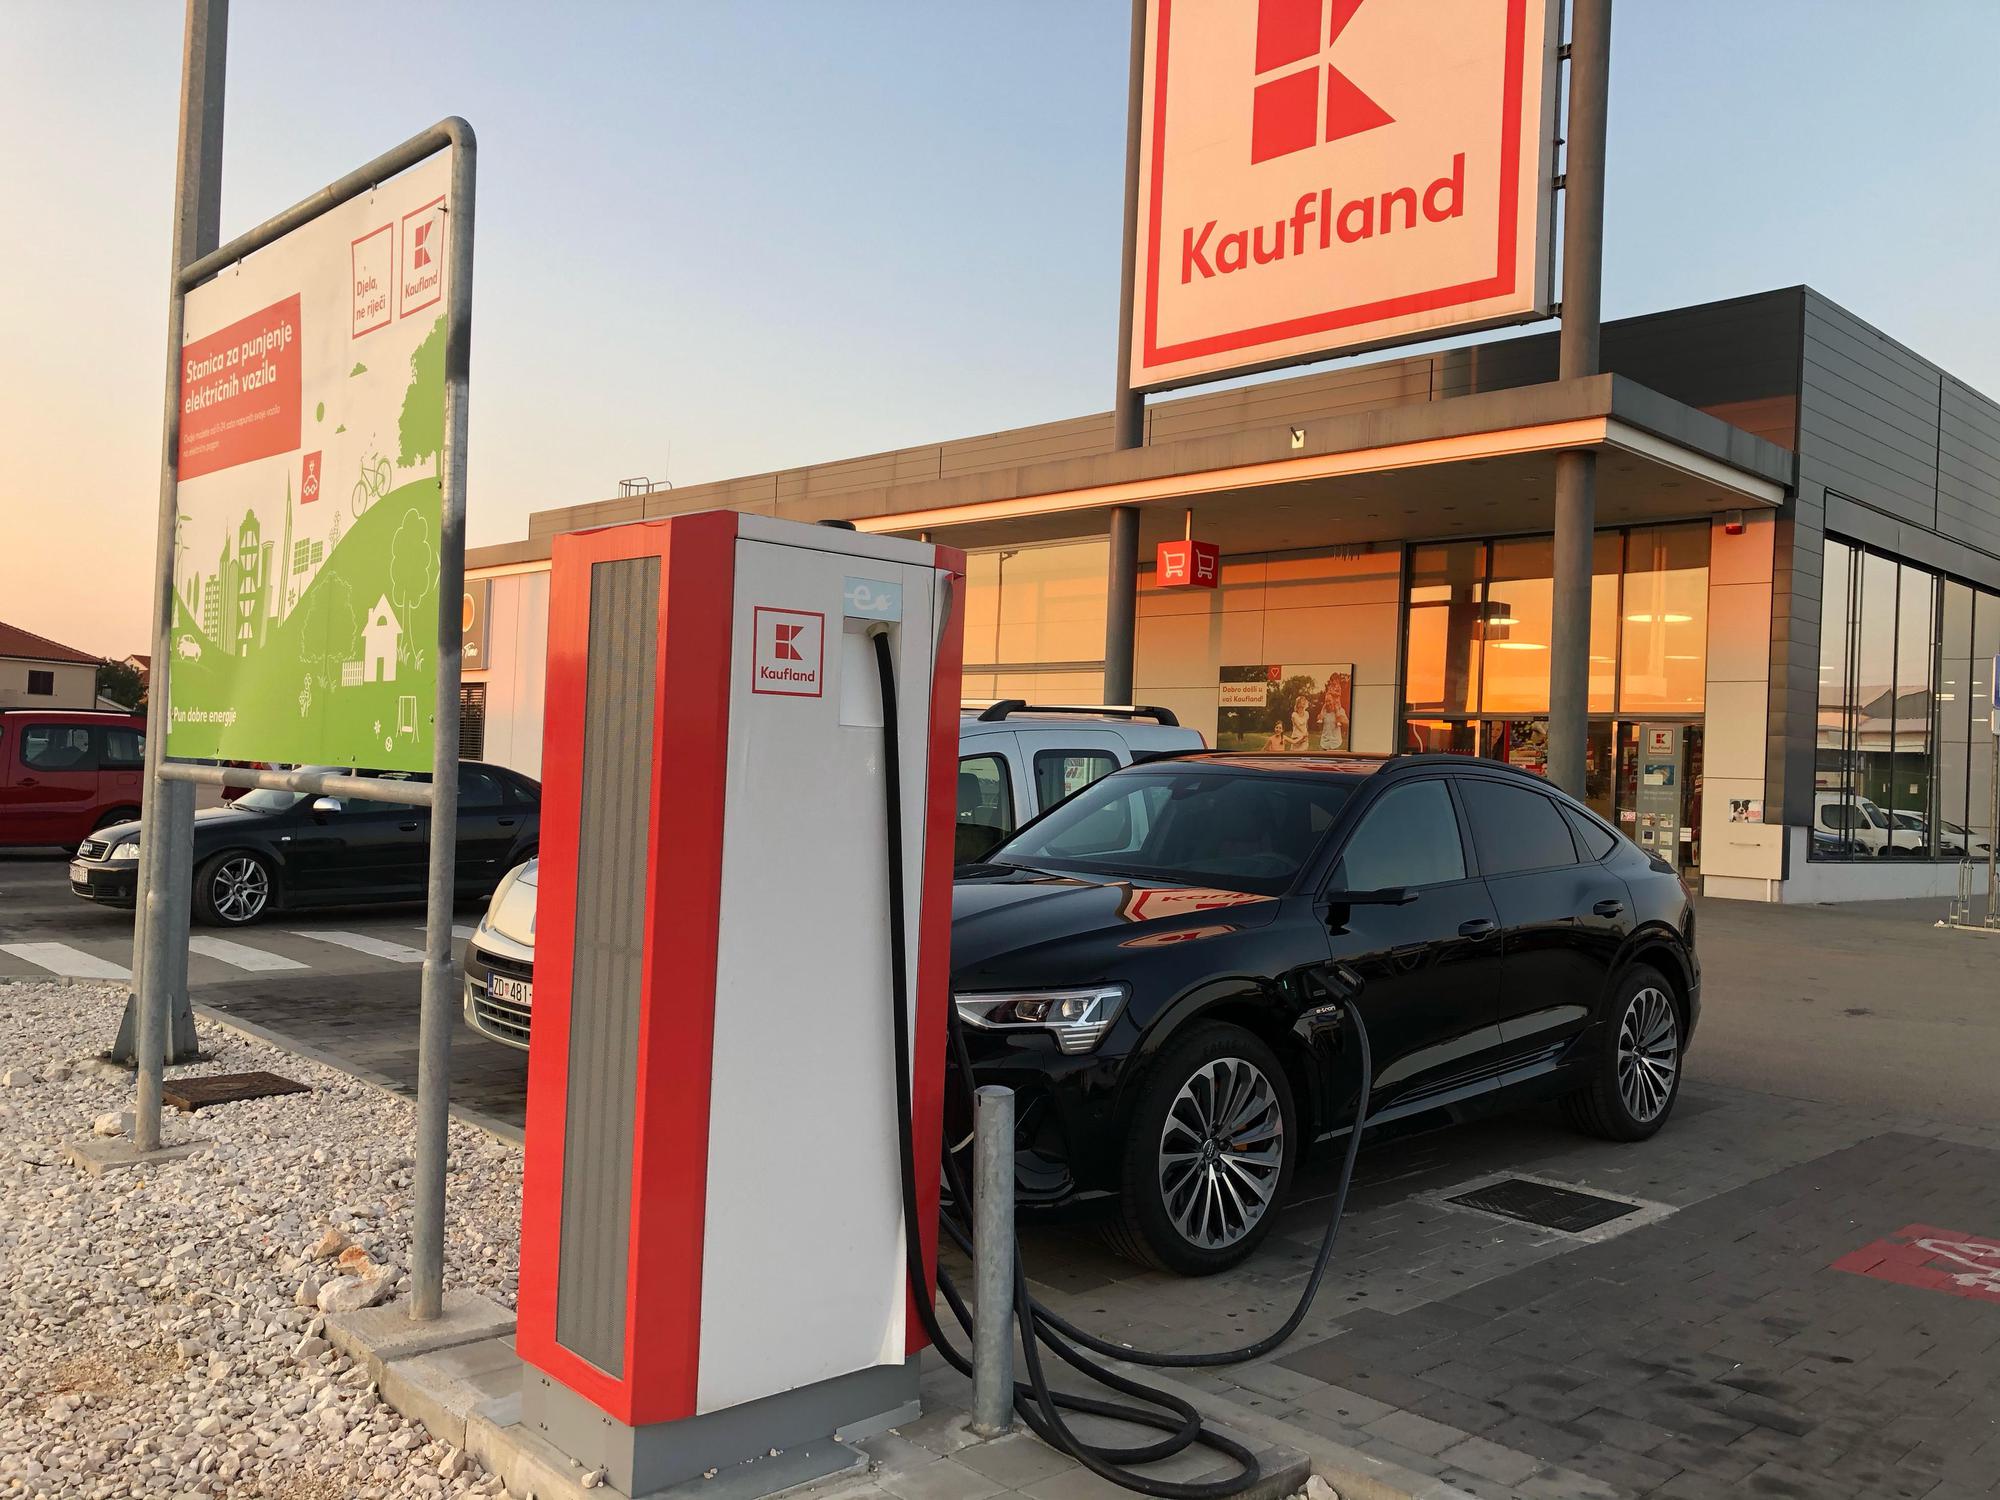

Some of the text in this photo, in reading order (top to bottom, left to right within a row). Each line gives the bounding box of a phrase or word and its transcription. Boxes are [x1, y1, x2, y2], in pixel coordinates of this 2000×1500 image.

[1181, 152, 1465, 285] Kaufland
[356, 276, 378, 298] Djela,
[404, 269, 438, 299] Kaufland
[356, 294, 386, 321] ne riječi
[186, 320, 293, 384] Stanica za punjenje
[185, 360, 276, 414] električnih vozila
[760, 666, 815, 682] Kaufland
[187, 706, 208, 723] dobre
[494, 977, 504, 996] ZD
[1315, 1005, 1336, 1014] e-tron
